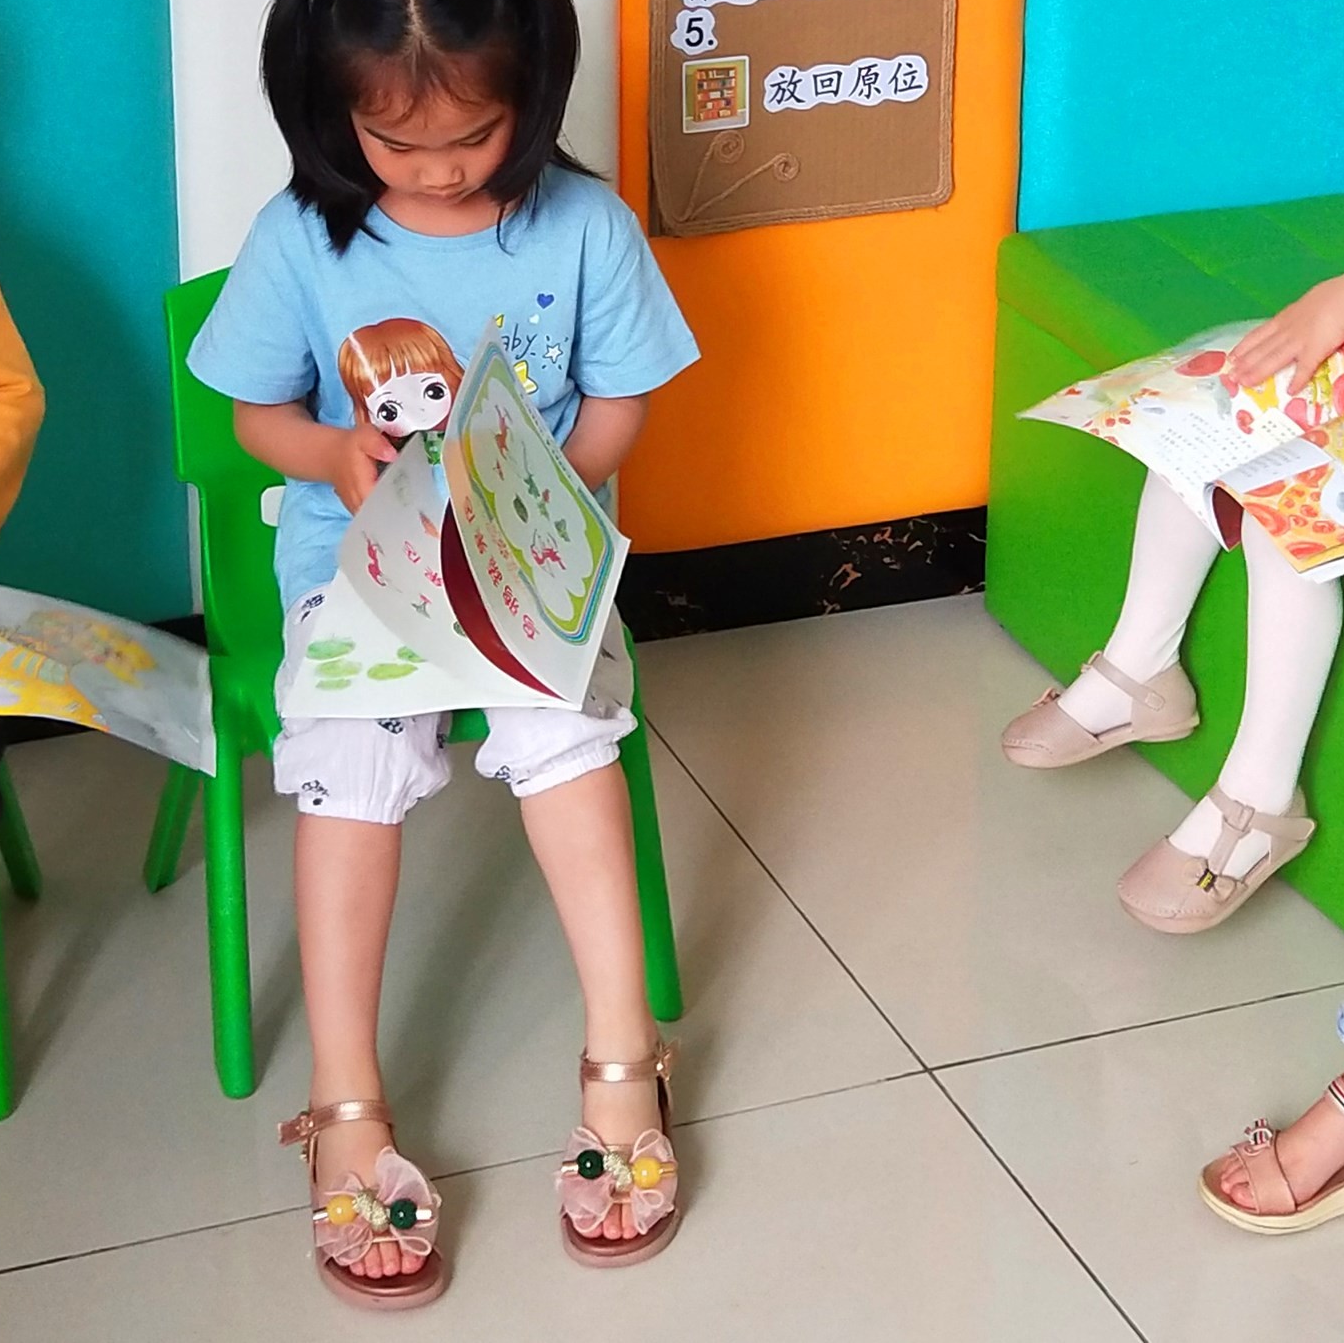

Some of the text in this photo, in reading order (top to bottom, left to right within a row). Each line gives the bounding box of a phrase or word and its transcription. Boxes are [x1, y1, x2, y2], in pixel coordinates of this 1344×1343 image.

[684, 17, 715, 48] 5.
[768, 62, 924, 106] 放回原位
